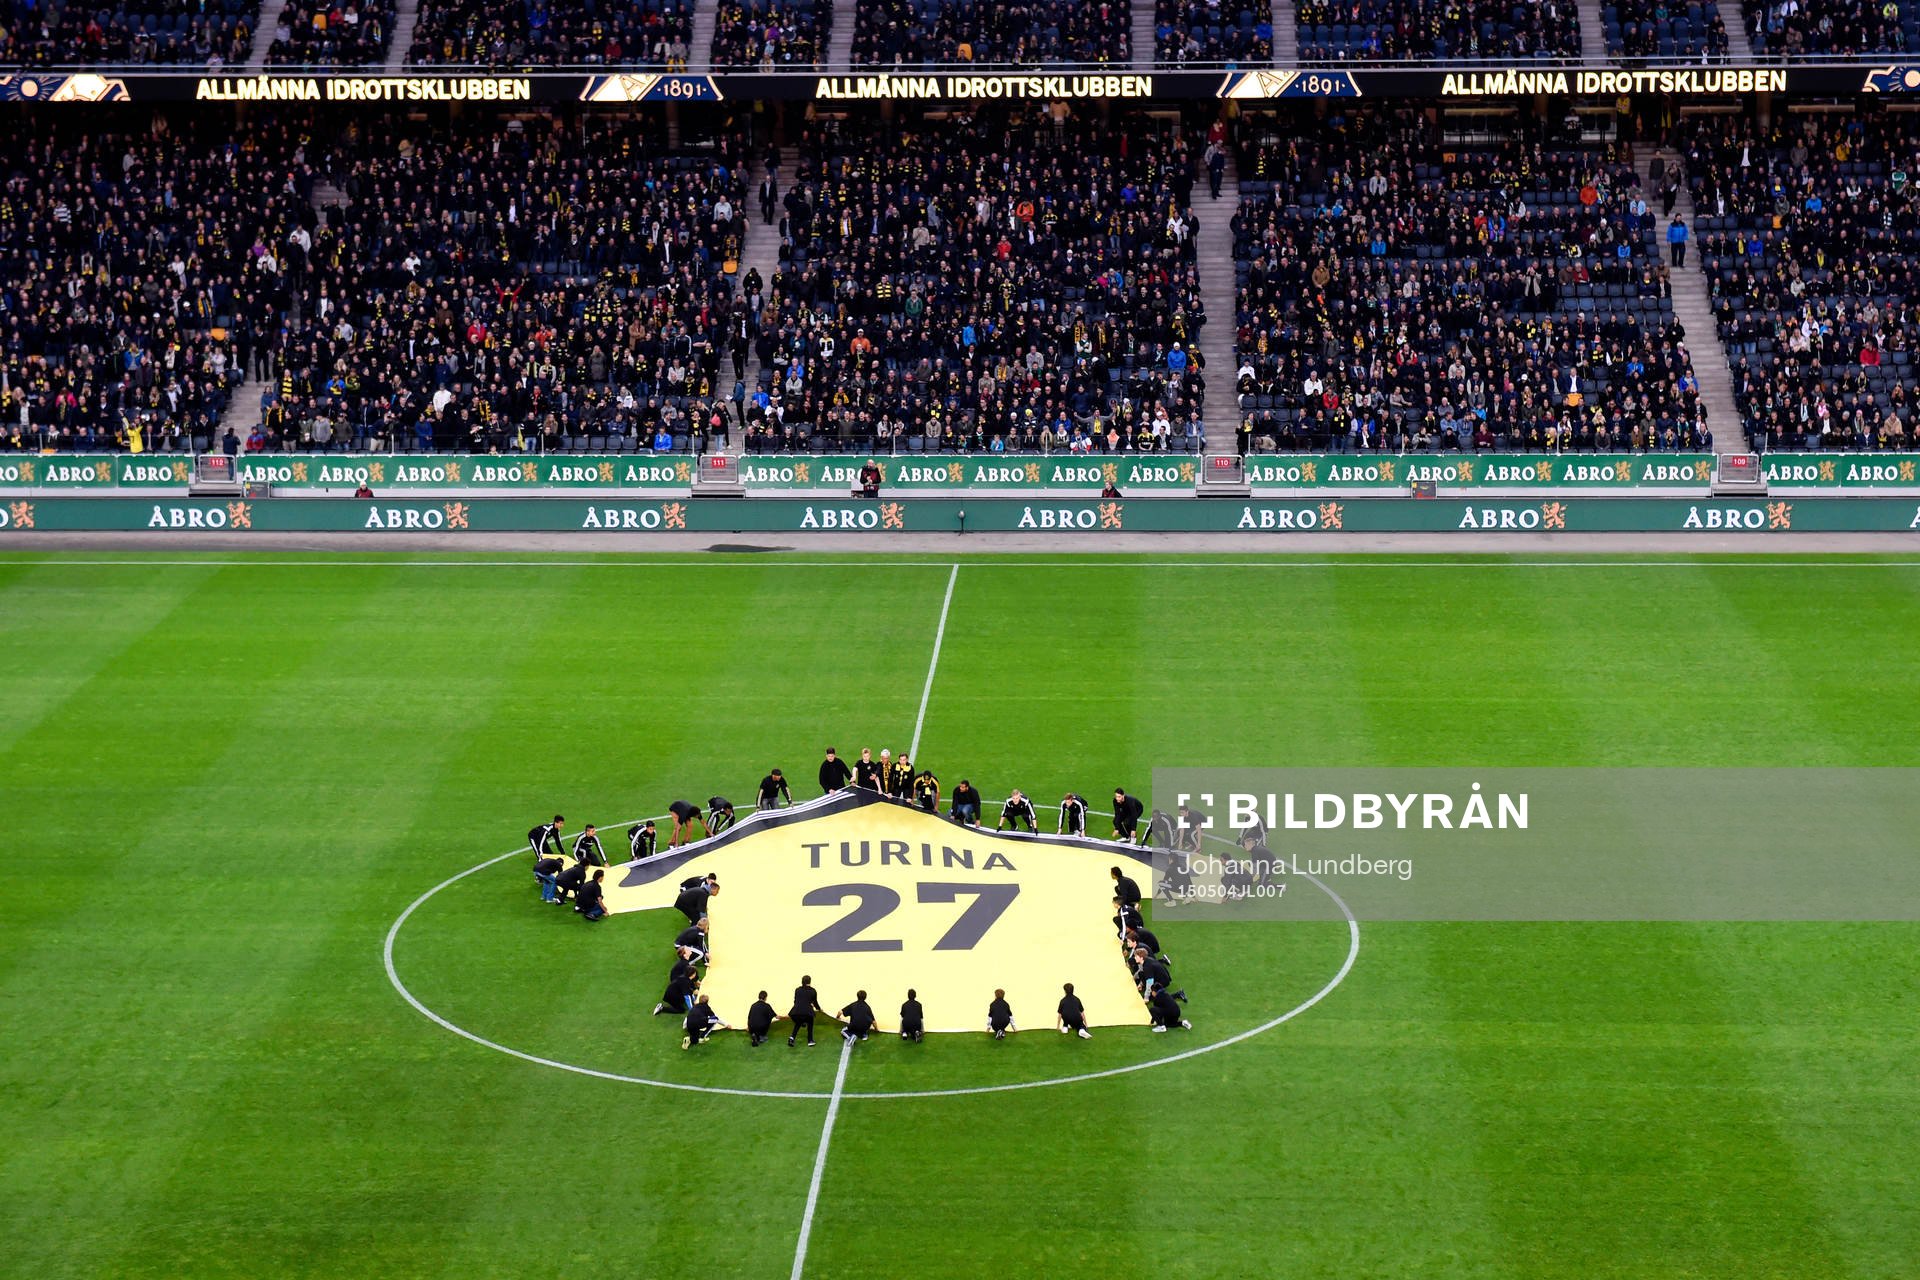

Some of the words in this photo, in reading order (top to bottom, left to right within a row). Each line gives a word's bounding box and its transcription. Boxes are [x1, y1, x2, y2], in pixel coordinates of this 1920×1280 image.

[196, 75, 321, 101] ALLMÄNNA
[326, 78, 530, 100] IDROTTSKLUBBEN
[815, 74, 941, 99] ALLMÄNNA
[947, 76, 1153, 98] IDROTTSKLUBBEN
[1441, 69, 1569, 95] ALLMÄNNA
[1576, 70, 1788, 94] IDROTTSKLUBBEN
[45, 465, 95, 482] ÅBRO
[122, 465, 172, 482] ÅBRO
[243, 465, 292, 482] ÅBRO
[319, 465, 369, 482] ÅBRO
[395, 465, 445, 482] ÅBRO
[472, 465, 522, 482] ÅBRO
[548, 465, 598, 482] ÅBRO
[625, 465, 675, 482] ÅBRO
[744, 465, 794, 482] ÅBRO
[898, 465, 948, 482] ÅBRO
[975, 465, 1025, 482] ÅBRO
[1052, 465, 1102, 482] ÅBRO
[1129, 465, 1179, 482] ÅBRO
[1250, 465, 1300, 482] ÅBRO
[1328, 465, 1378, 482] ÅBRO
[1406, 464, 1457, 481] ÅBRO
[1484, 464, 1535, 481] ÅBRO
[1563, 464, 1614, 481] ÅBRO
[1642, 464, 1693, 481] ÅBRO
[1766, 464, 1818, 481] ÅBRO
[1846, 464, 1898, 481] ÅBRO
[148, 506, 227, 529] ÅBRO
[365, 506, 443, 529] ÅBRO
[582, 506, 661, 529] ÅBRO
[800, 506, 879, 529] ÅBRO
[1018, 506, 1097, 529] ÅBRO
[1237, 506, 1318, 529] ÅBRO
[1458, 506, 1540, 529] ÅBRO
[1682, 506, 1766, 529] ÅBRO
[801, 839, 1018, 871] TURINA
[801, 882, 1020, 953] 27
